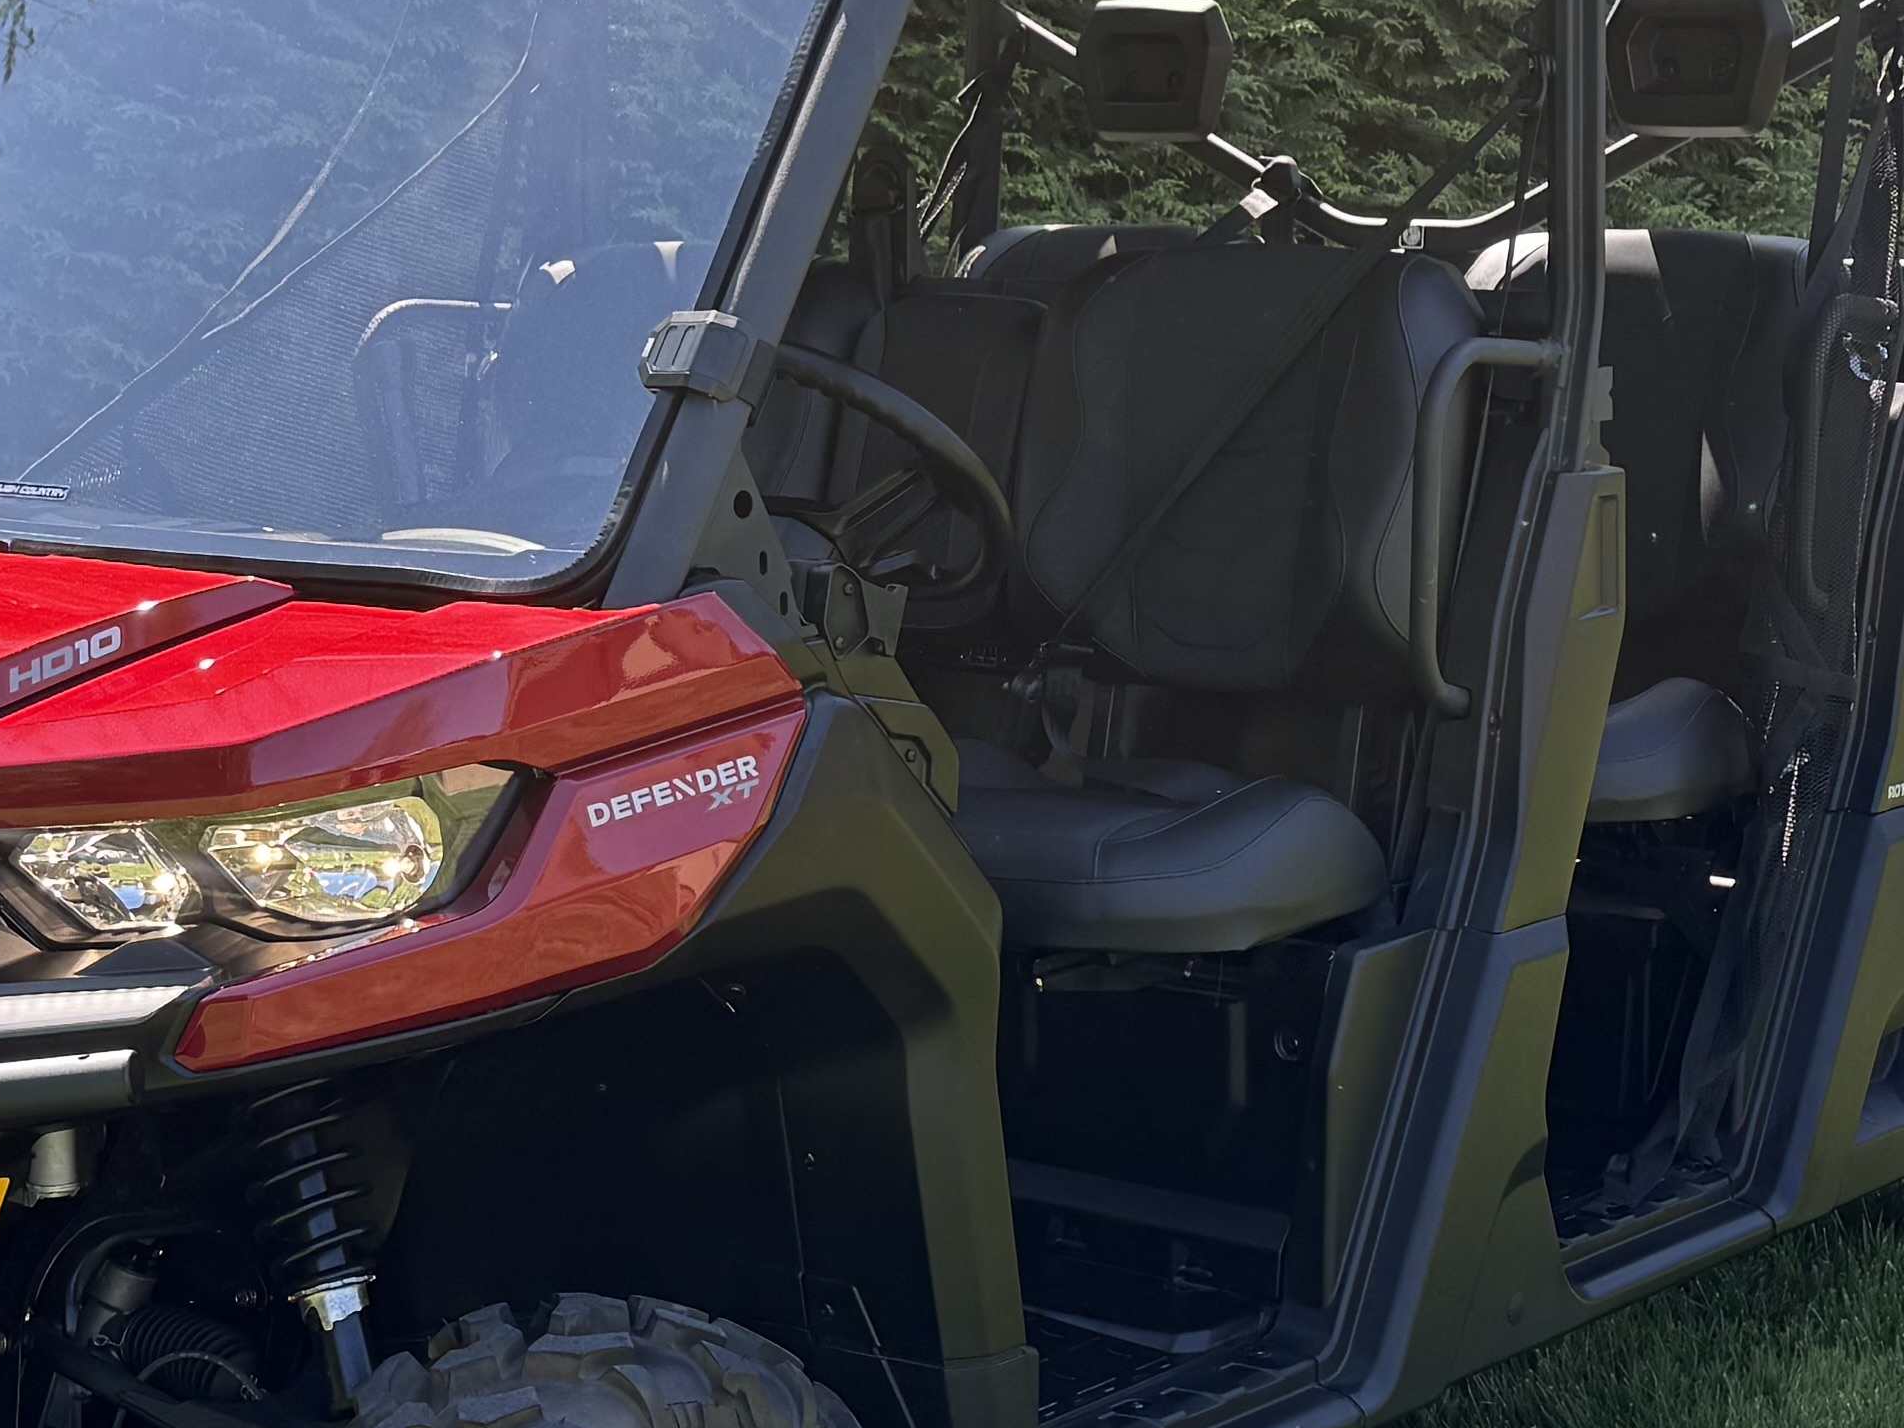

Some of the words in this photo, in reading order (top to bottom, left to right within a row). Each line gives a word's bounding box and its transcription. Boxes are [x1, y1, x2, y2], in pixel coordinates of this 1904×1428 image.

[9, 625, 121, 693] HD10
[587, 755, 760, 827] DEFENDER
[704, 779, 760, 813] XT
